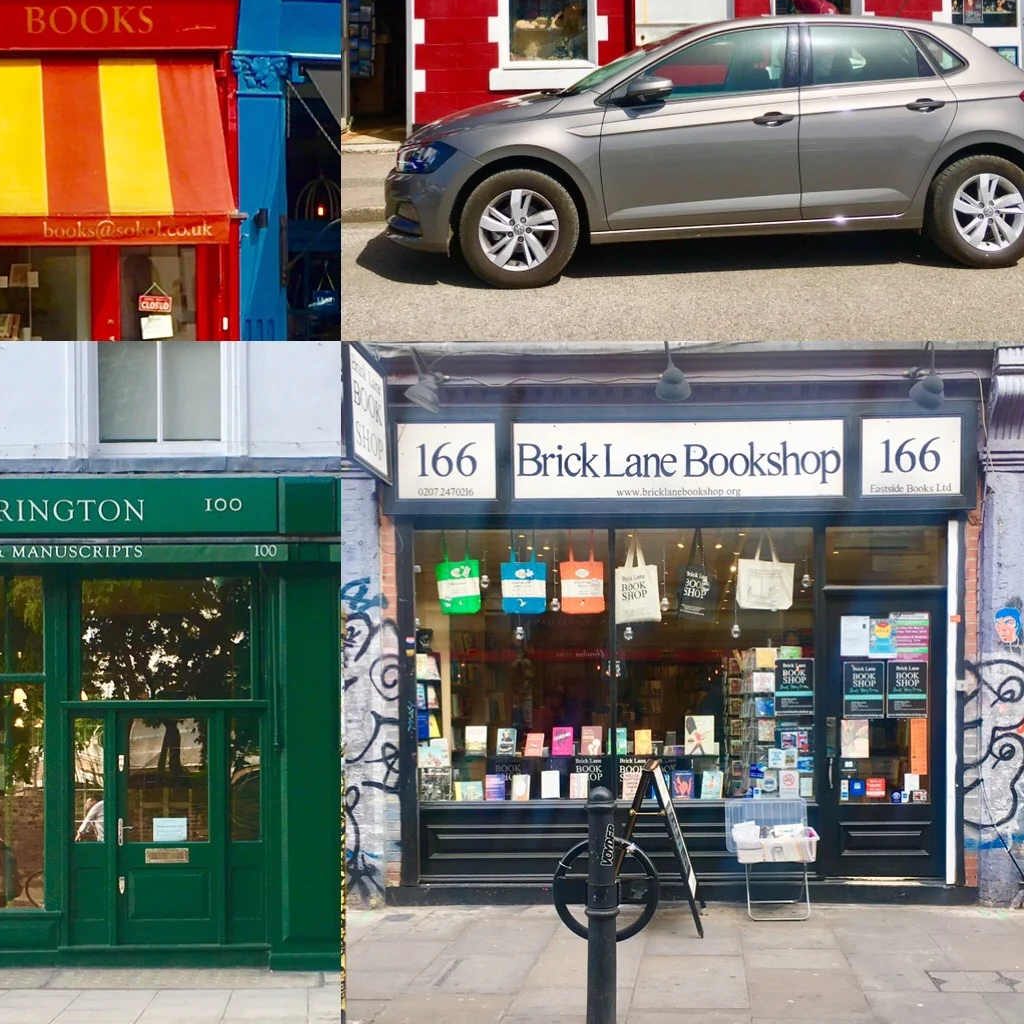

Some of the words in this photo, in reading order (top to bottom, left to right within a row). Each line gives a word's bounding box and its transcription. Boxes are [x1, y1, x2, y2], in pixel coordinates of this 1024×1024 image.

[24, 5, 154, 35] BOOKS
[42, 219, 213, 242] books@sokol.co.uk
[141, 300, 170, 310] CLOSED
[353, 379, 383, 428] BOOK
[355, 420, 384, 461] SHOP
[416, 441, 477, 477] 166
[880, 436, 941, 474] 166
[516, 441, 600, 478] Brick
[603, 443, 677, 477] Lane
[683, 440, 842, 484] Bookshop
[616, 486, 741, 498] www.bricklanebookshop.org
[870, 484, 905, 494] Eastside
[906, 483, 934, 494] Books
[936, 483, 952, 493] Ltd
[12, 544, 143, 558] MANUSCRIPTS
[254, 544, 277, 557] 100
[621, 581, 647, 592] BOOK
[683, 586, 707, 599] SHOP
[621, 589, 648, 601] SHOP
[782, 669, 806, 677] BOOK
[782, 676, 807, 684] SHOP
[852, 680, 876, 688] SHOP
[895, 679, 920, 687] SHOP
[576, 764, 603, 773] BOOK
[600, 823, 615, 867] VOYDER
